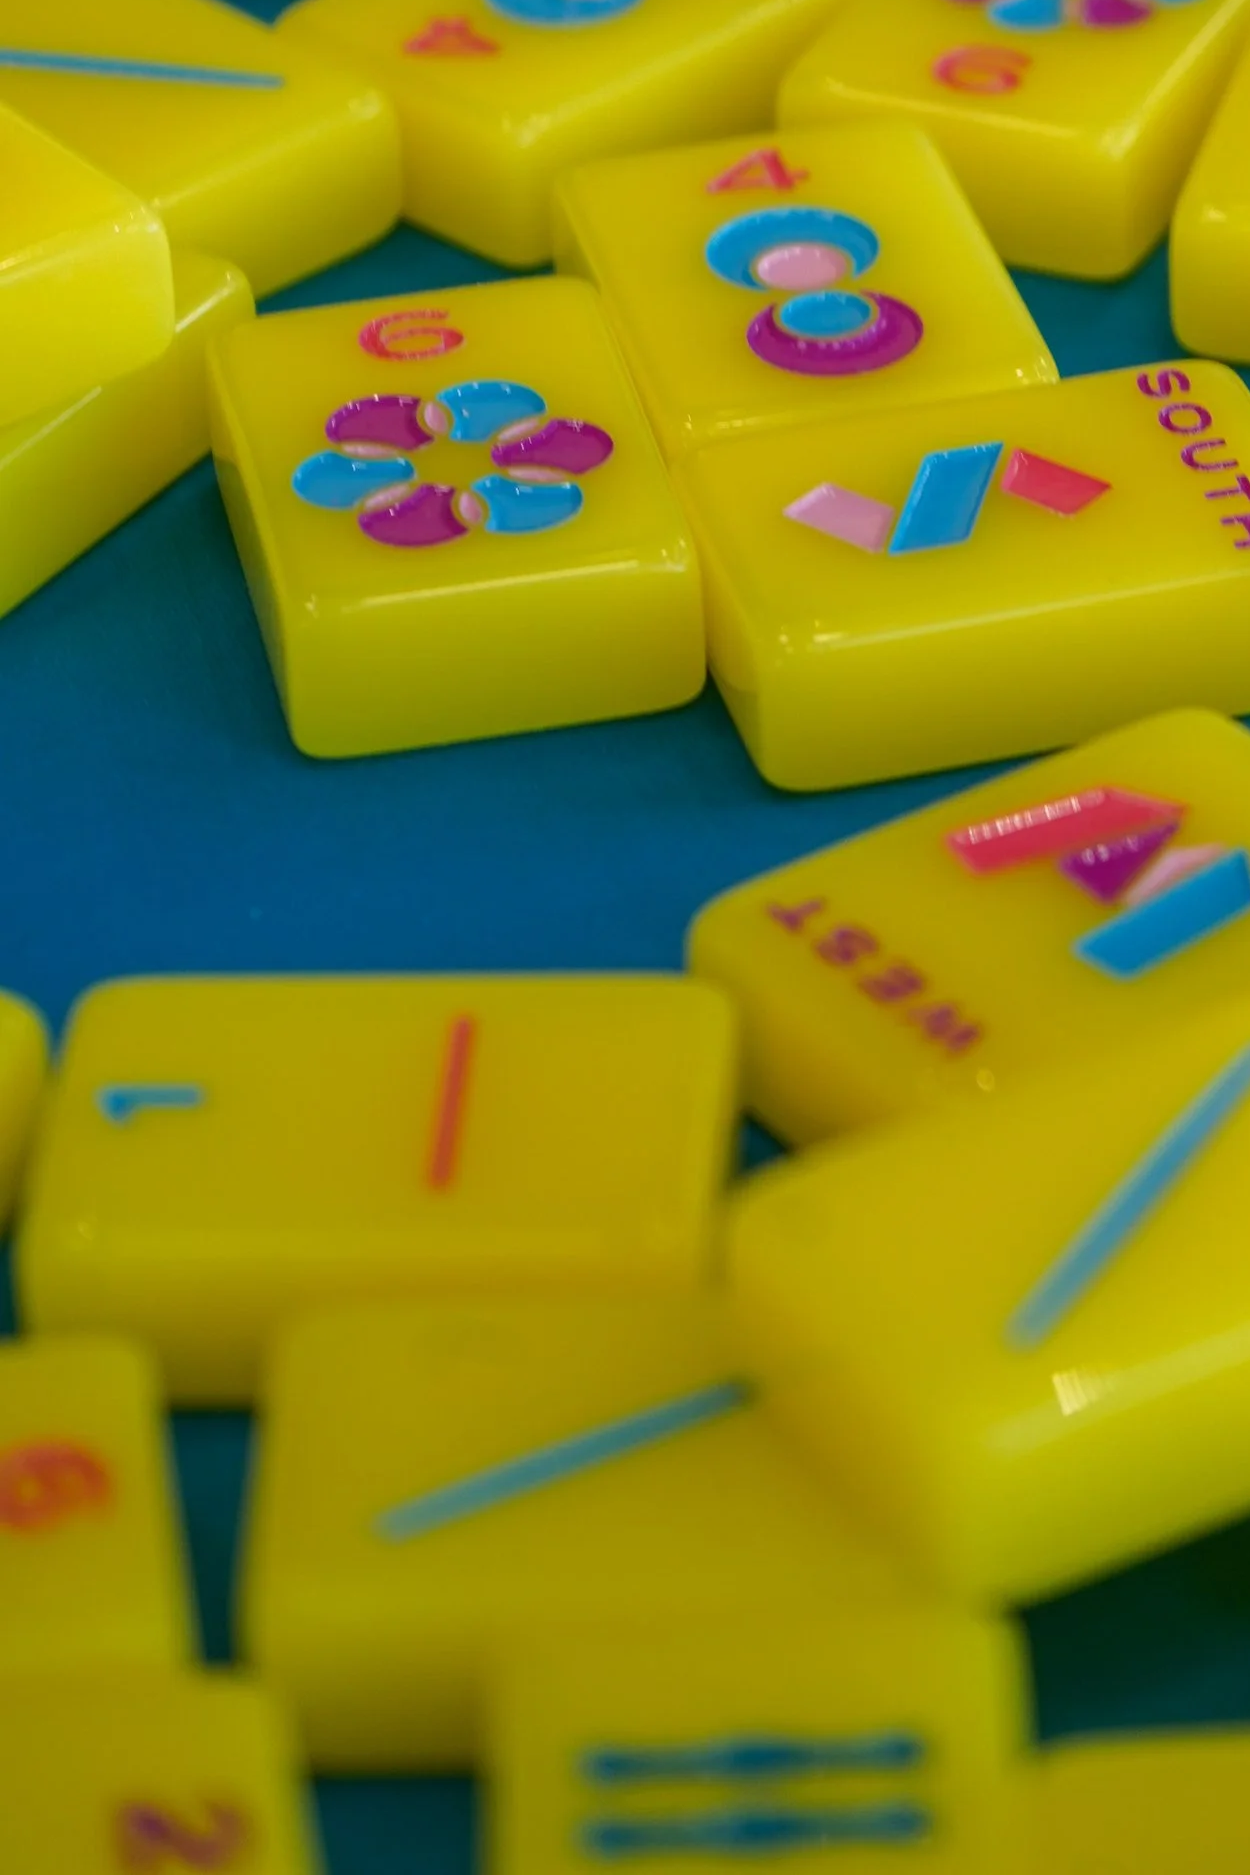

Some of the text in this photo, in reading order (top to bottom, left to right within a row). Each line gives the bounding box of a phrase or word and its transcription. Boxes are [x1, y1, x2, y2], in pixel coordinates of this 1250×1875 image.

[403, 15, 501, 57] 4
[706, 147, 809, 194] 4
[358, 309, 464, 362] 6
[766, 897, 986, 1057] WEST
[97, 1082, 206, 1125] 1
